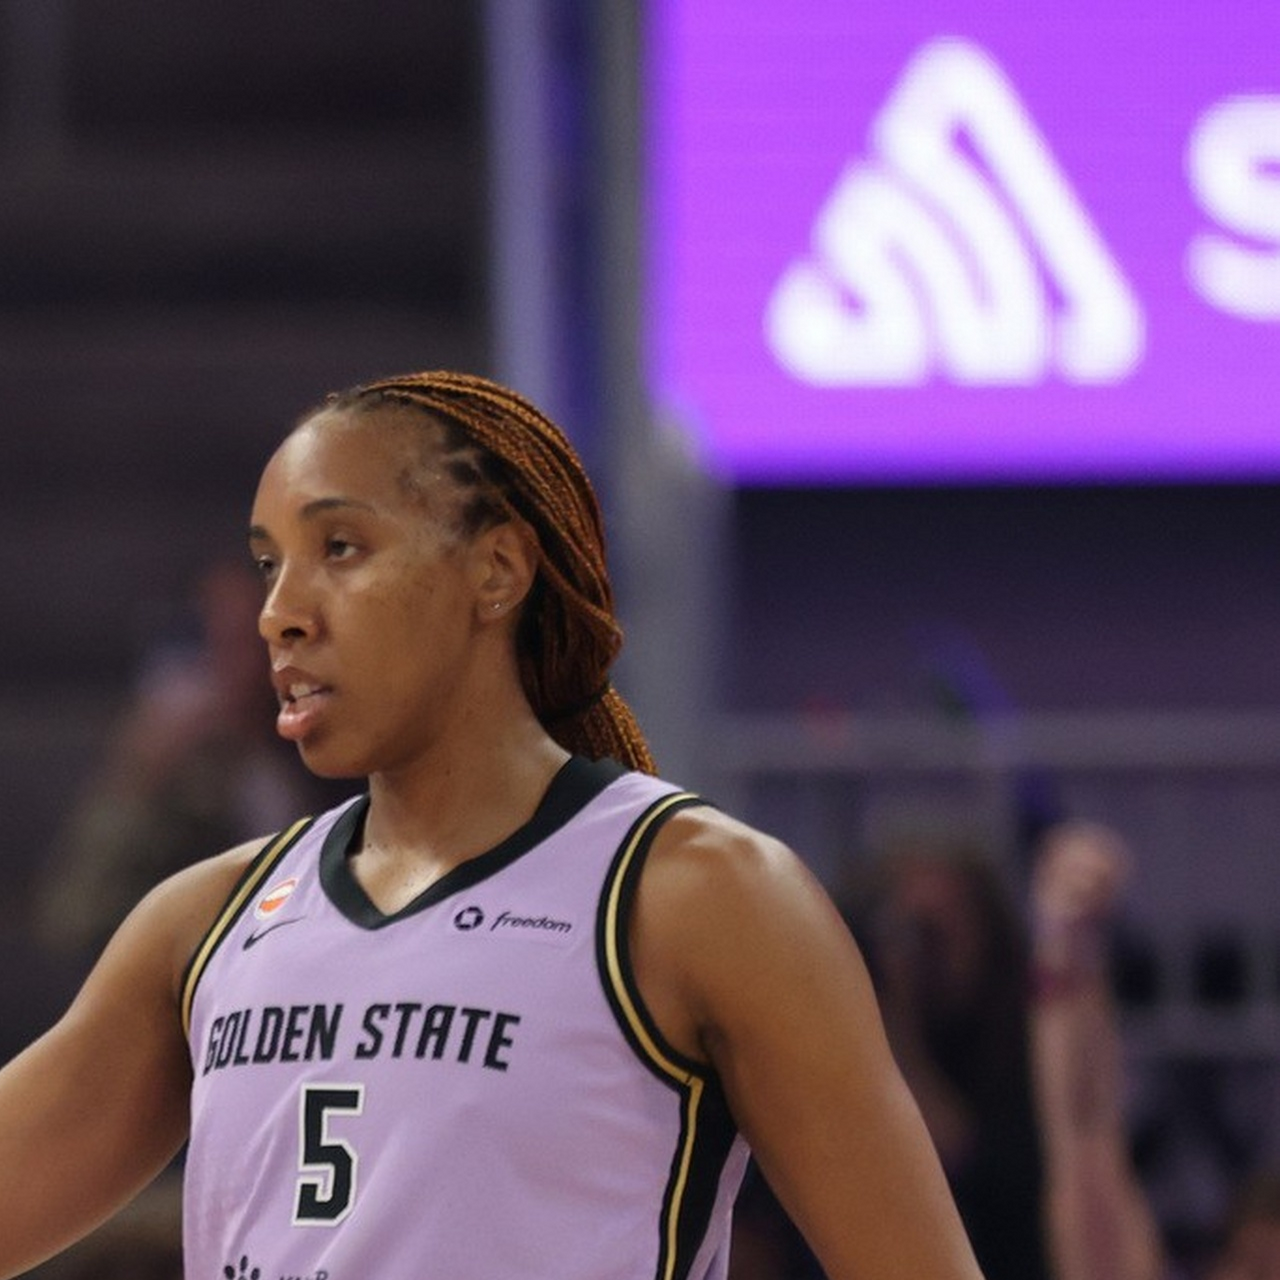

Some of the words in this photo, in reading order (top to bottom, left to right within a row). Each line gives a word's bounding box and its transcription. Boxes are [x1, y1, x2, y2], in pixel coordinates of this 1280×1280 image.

[490, 911, 572, 933] freedom
[203, 1003, 344, 1077] GOLDEN
[354, 1003, 521, 1072] STATE
[291, 1083, 365, 1227] 5
